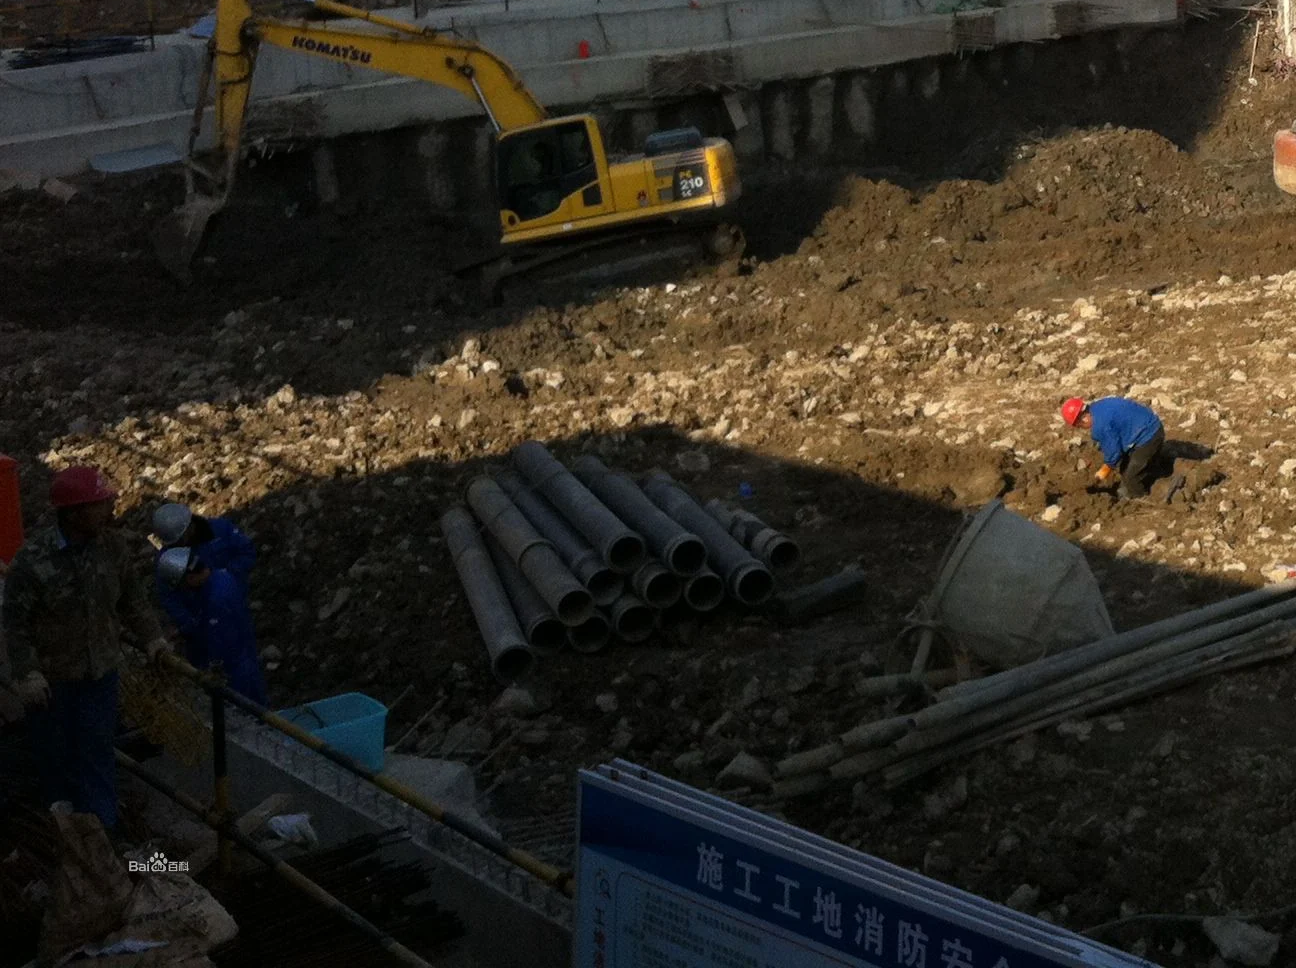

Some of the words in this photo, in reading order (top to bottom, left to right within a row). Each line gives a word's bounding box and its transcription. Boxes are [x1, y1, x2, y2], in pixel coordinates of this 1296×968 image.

[292, 35, 371, 63] KOMATSU
[680, 176, 704, 191] 210
[696, 841, 1012, 968] 施工工地消防安
